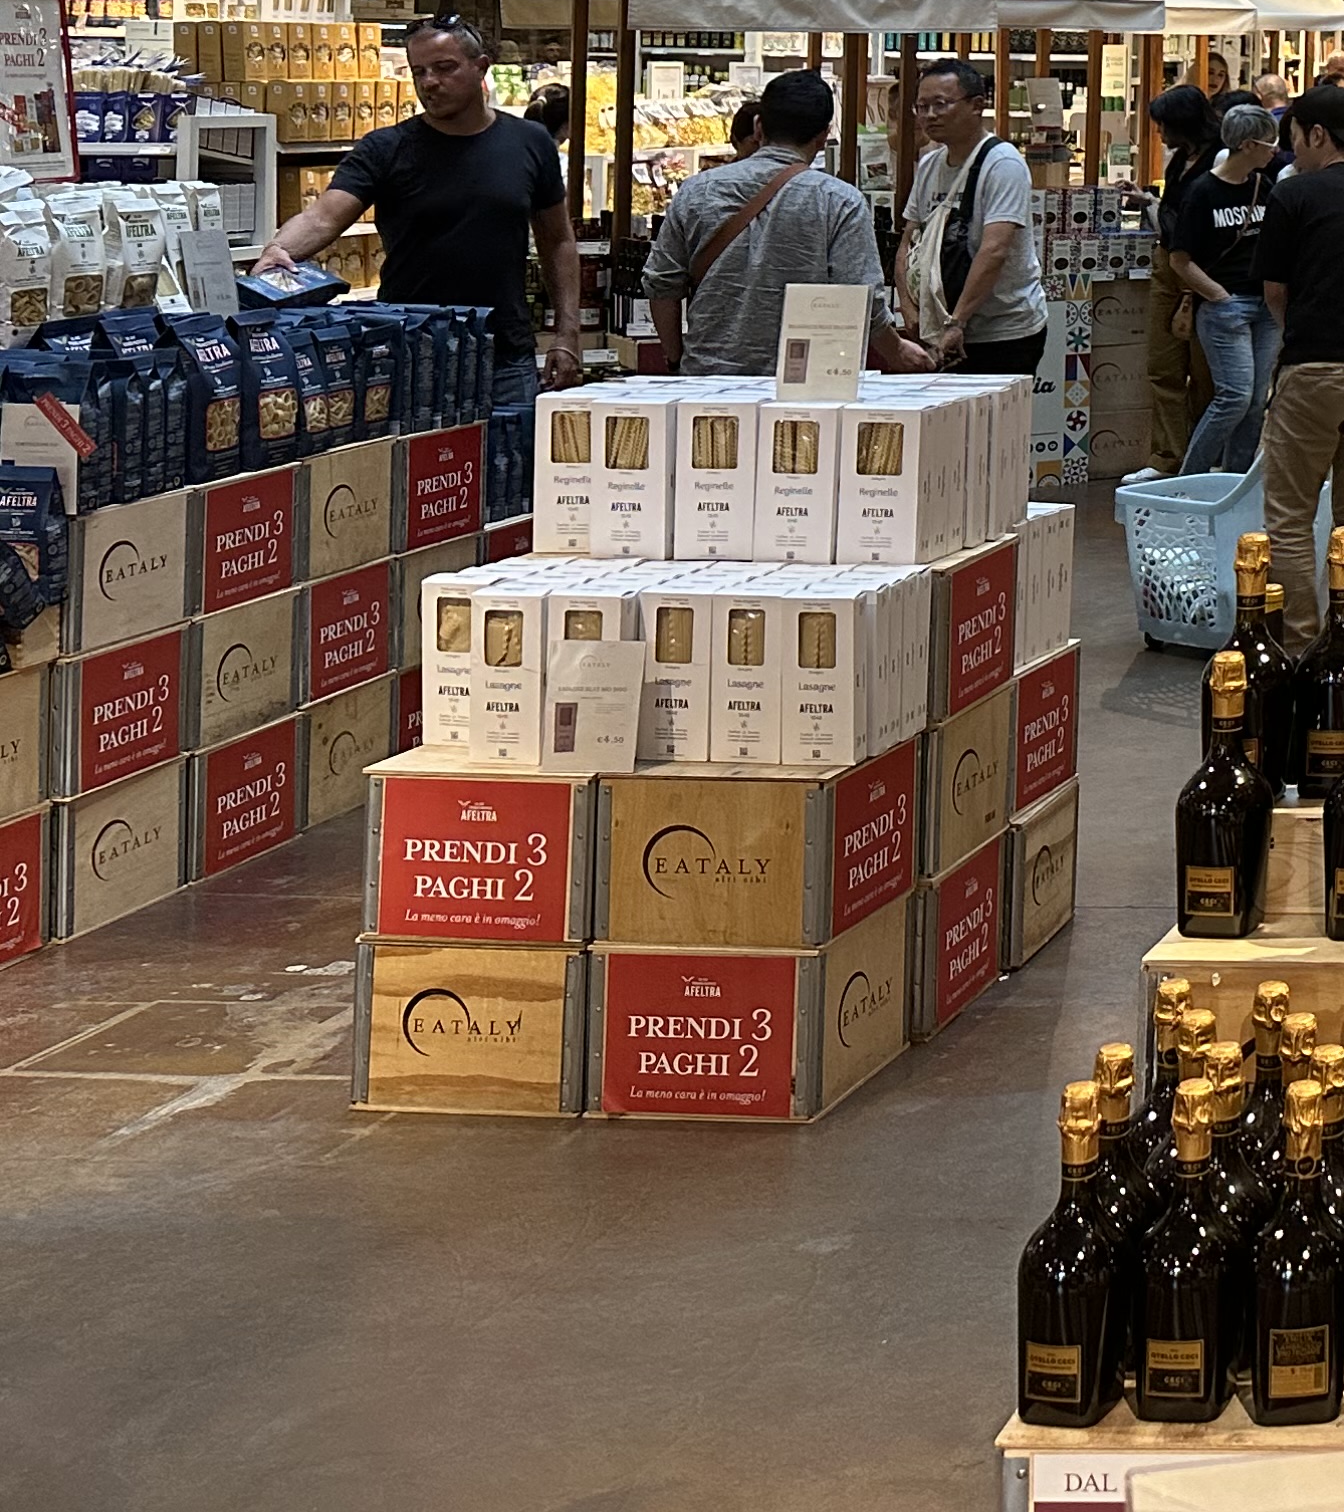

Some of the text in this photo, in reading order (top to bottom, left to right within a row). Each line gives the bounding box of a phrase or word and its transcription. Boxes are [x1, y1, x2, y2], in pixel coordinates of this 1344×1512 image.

[697, 502, 731, 512] AFELTRA
[216, 510, 284, 552] PRENDI 3
[105, 553, 168, 585] EATALY
[220, 539, 278, 580] PAGHI 2
[727, 700, 762, 711] AFELTRA
[460, 809, 497, 822] AFELTRA
[403, 832, 548, 867] PRENDI 3
[655, 857, 771, 875] EATALY
[413, 868, 535, 902] PAGHI 2
[405, 908, 419, 922] La
[421, 913, 448, 923] meno
[450, 914, 472, 924] cara
[482, 912, 493, 925] in
[494, 912, 541, 930] omaggio!
[627, 1008, 773, 1042] PRENDI 3
[637, 1044, 760, 1077] PAGHI 2
[1064, 1472, 1118, 1493] DAL
